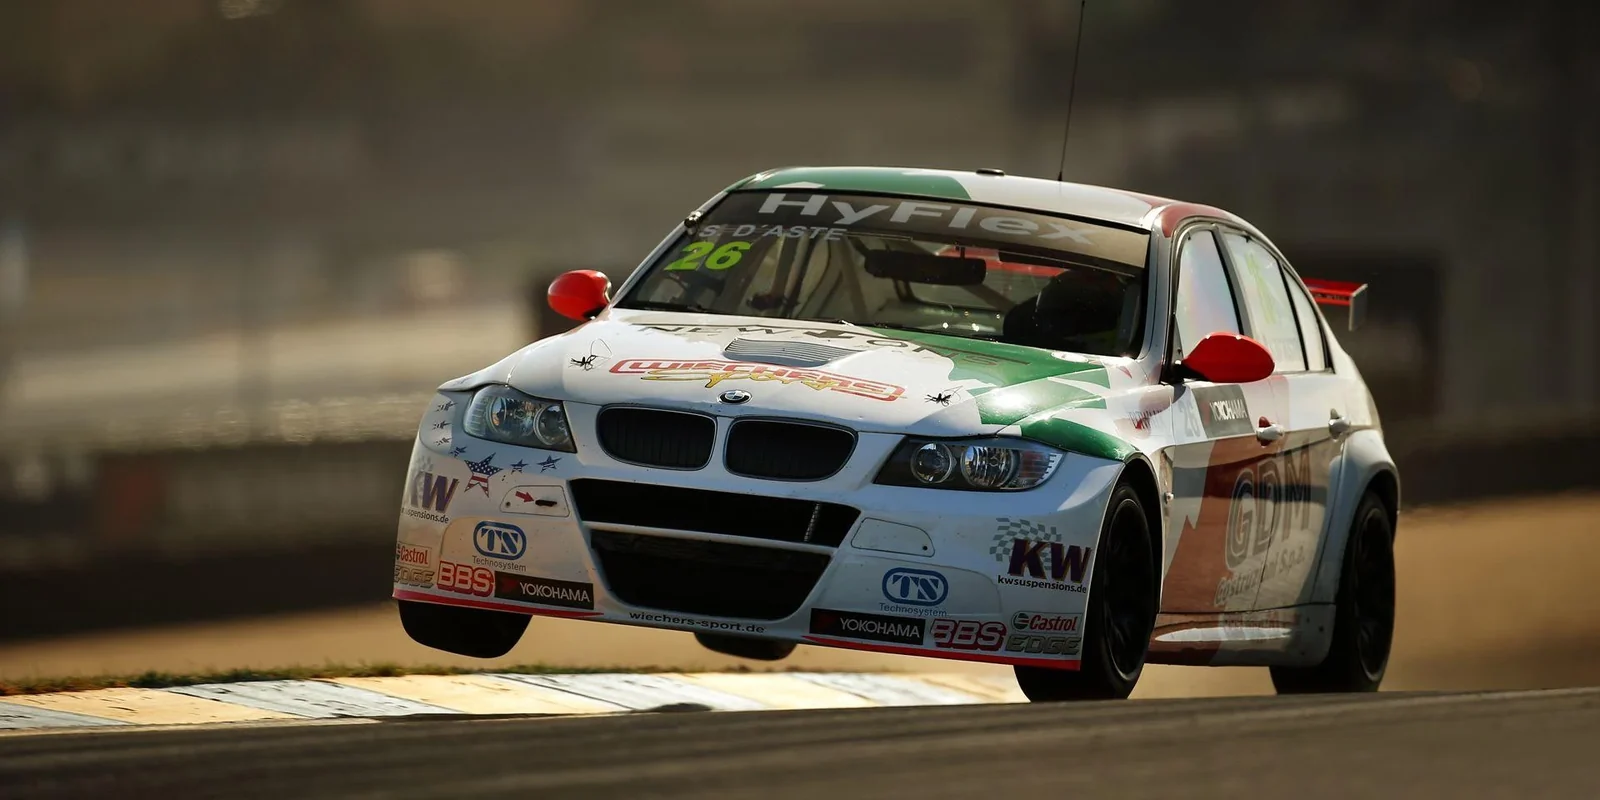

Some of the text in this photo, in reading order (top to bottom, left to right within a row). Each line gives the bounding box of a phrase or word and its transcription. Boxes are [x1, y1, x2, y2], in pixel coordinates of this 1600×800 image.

[758, 193, 1096, 246] HyFlex
[663, 241, 751, 271] 26
[1225, 441, 1313, 571] GDM
[400, 545, 429, 565] Castrol
[472, 555, 527, 572] Technosystem
[1007, 538, 1092, 583] KW
[437, 560, 495, 597] BBS
[892, 574, 939, 600] TS
[997, 574, 1087, 594] kwsuspensions.de
[520, 582, 590, 602] YOKOHAMA
[879, 602, 947, 618] Technosystem
[629, 611, 765, 634] wiechers-sport.de
[840, 617, 920, 638] YOKOHAMA
[1030, 614, 1078, 632] Castrol
[930, 618, 1006, 652] BBS
[1006, 634, 1082, 656] EDGE
